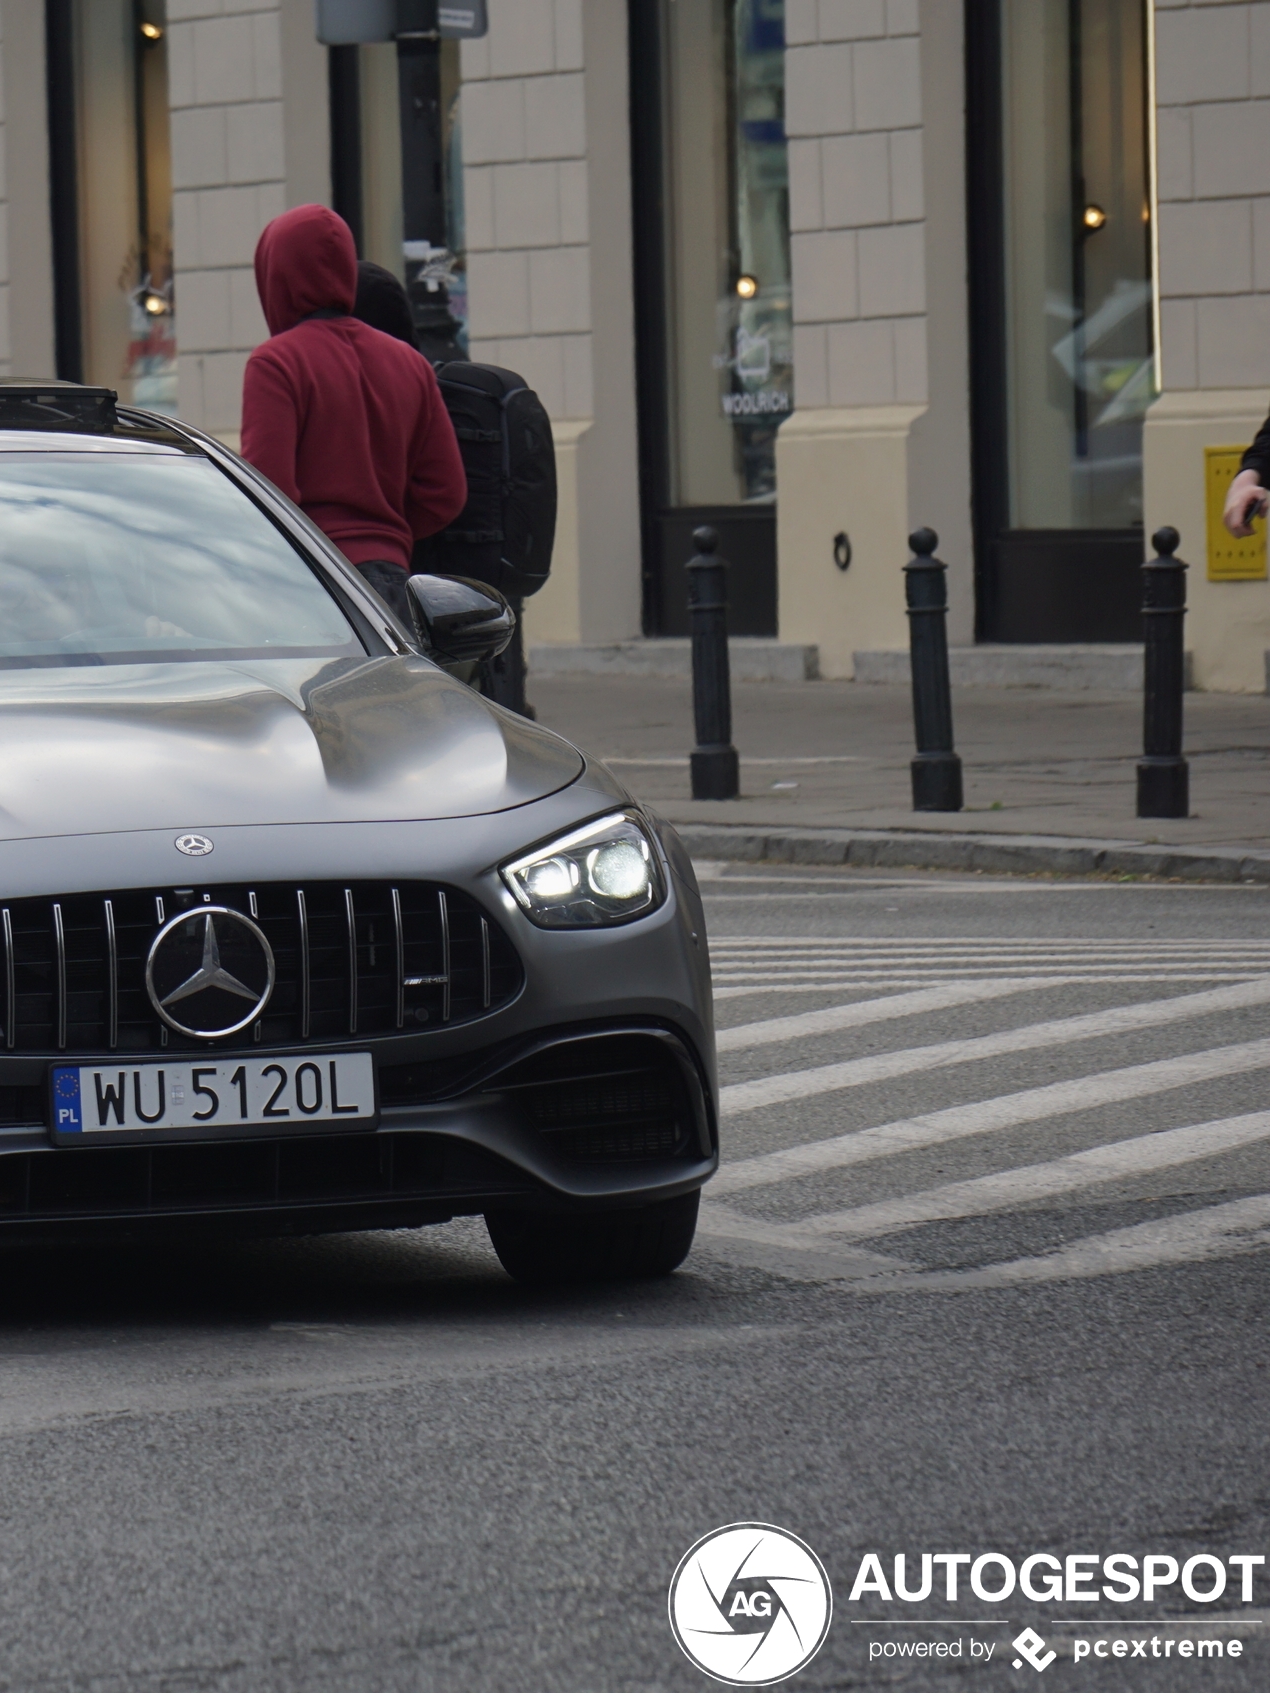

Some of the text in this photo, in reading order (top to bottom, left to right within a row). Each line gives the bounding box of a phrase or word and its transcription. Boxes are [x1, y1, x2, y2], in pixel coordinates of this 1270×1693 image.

[722, 391, 789, 414] WOOLRICH
[93, 1060, 360, 1126] WU 5120L
[58, 1108, 79, 1124] PL
